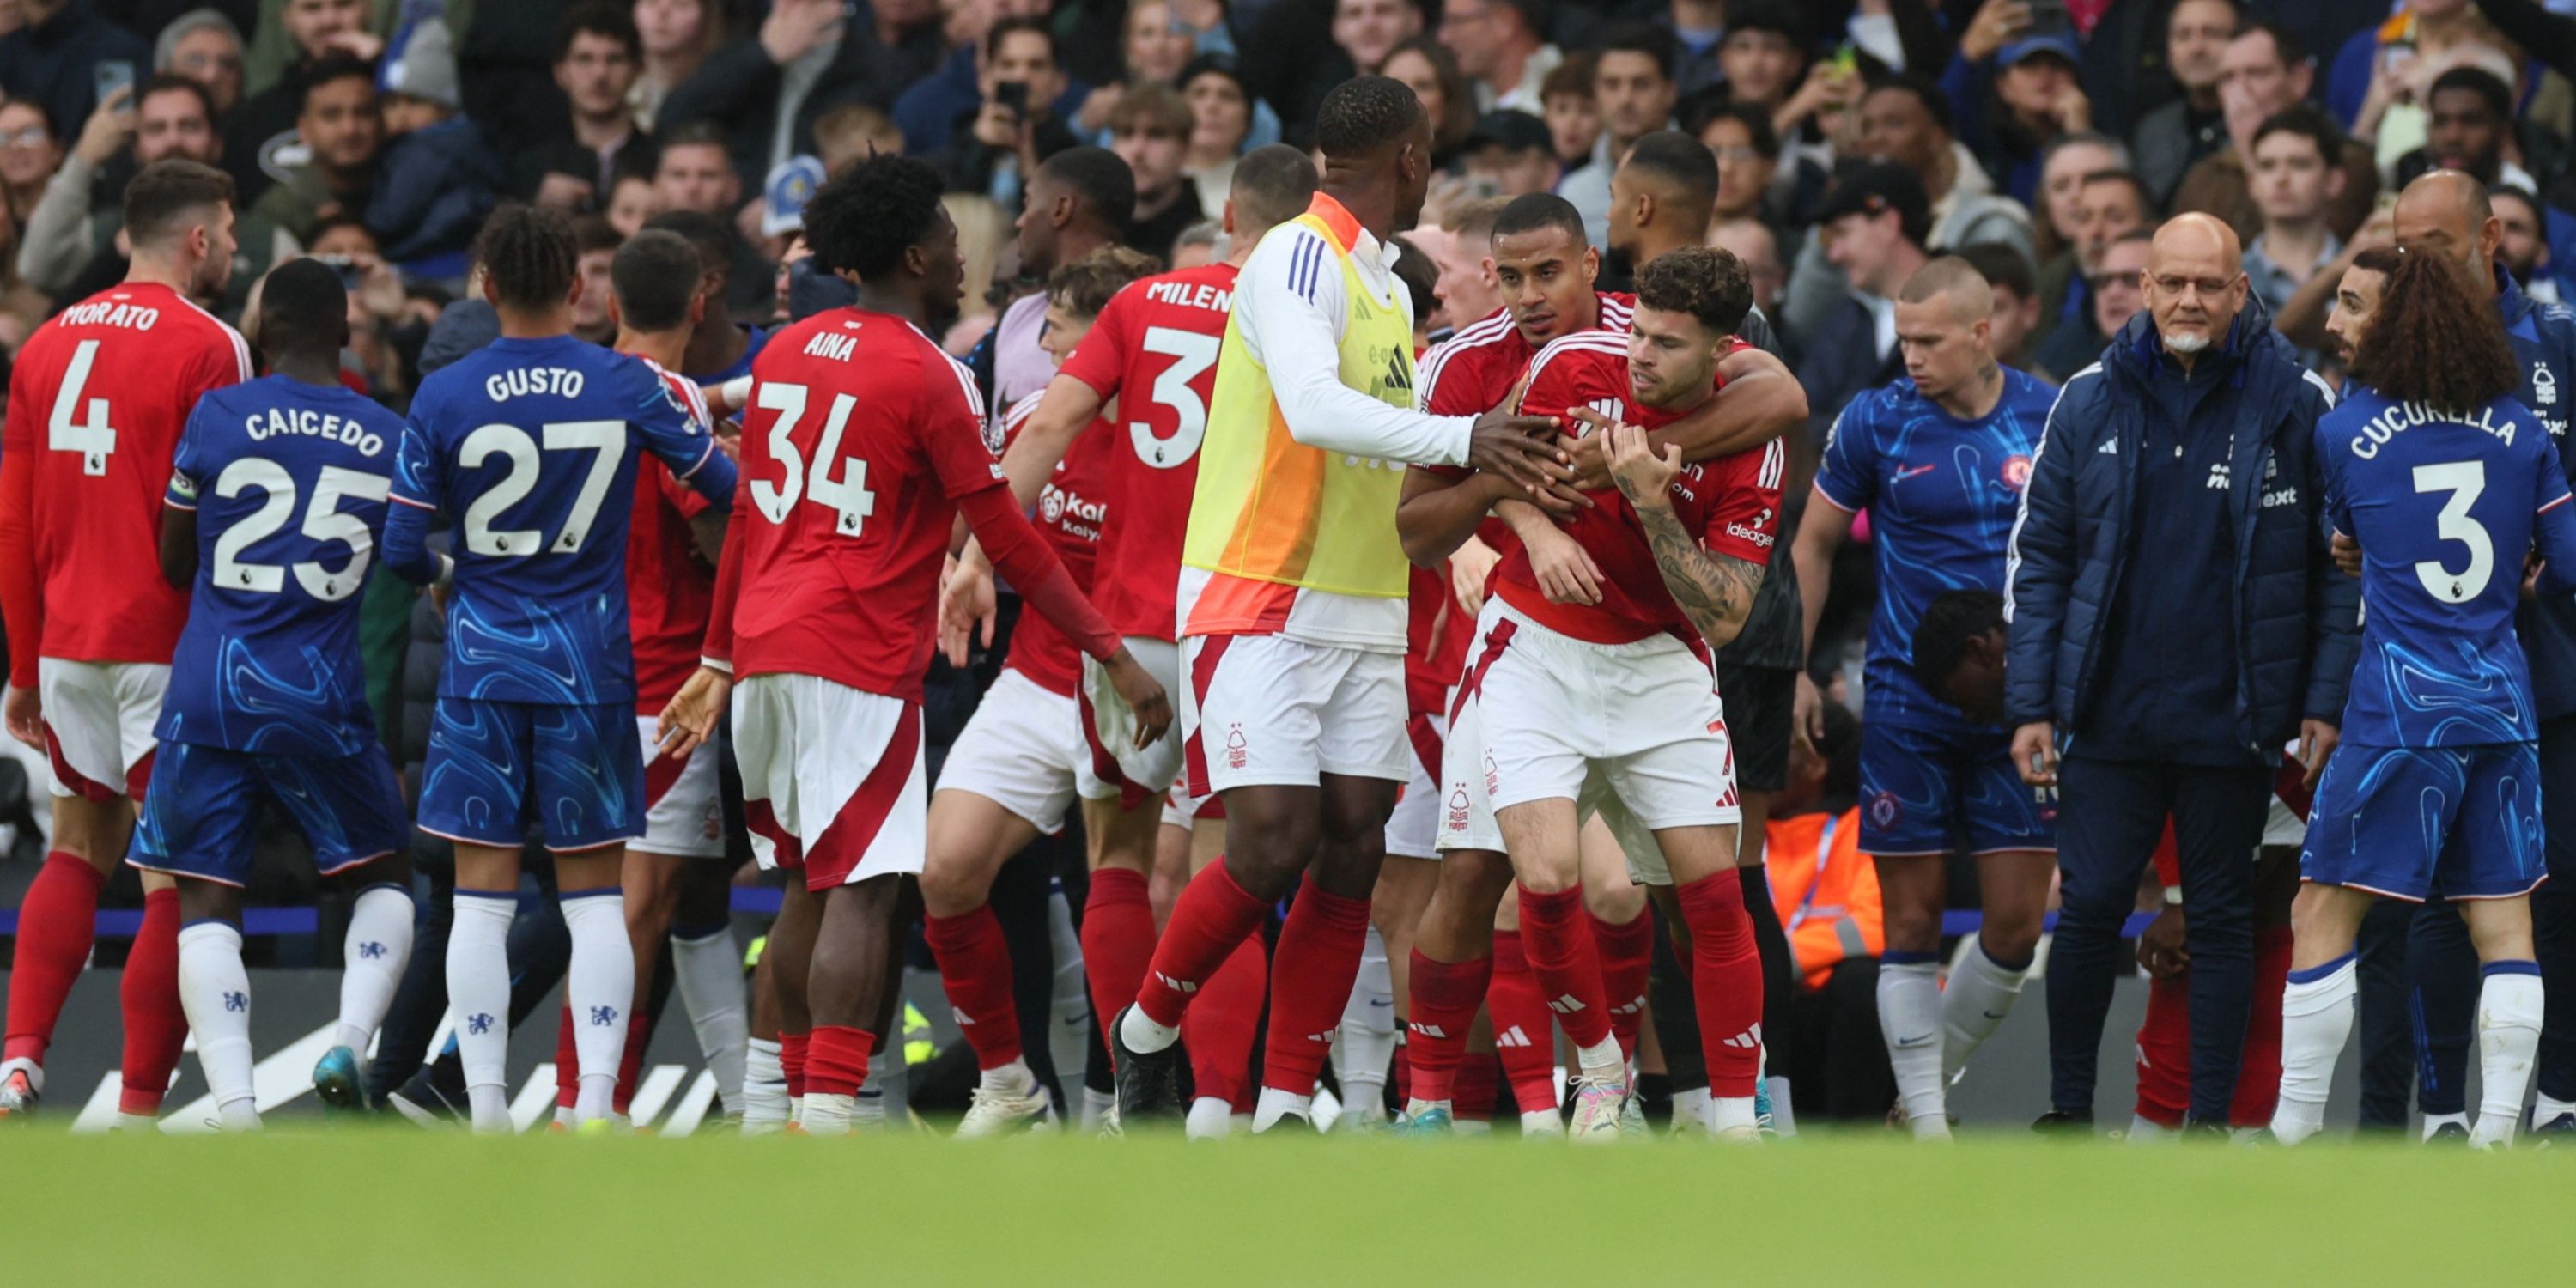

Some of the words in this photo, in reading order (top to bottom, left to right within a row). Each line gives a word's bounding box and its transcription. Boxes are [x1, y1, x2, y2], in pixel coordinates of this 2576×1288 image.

[60, 301, 159, 331] MORATO
[804, 331, 858, 362] AINA
[49, 340, 117, 476] 4
[246, 408, 383, 457] CAICEDO
[486, 367, 584, 402] GUSTO
[1129, 325, 1222, 469] 3
[459, 419, 627, 556] 27
[750, 381, 875, 537] 34
[213, 457, 392, 602] 25
[2413, 460, 2494, 604] 3
